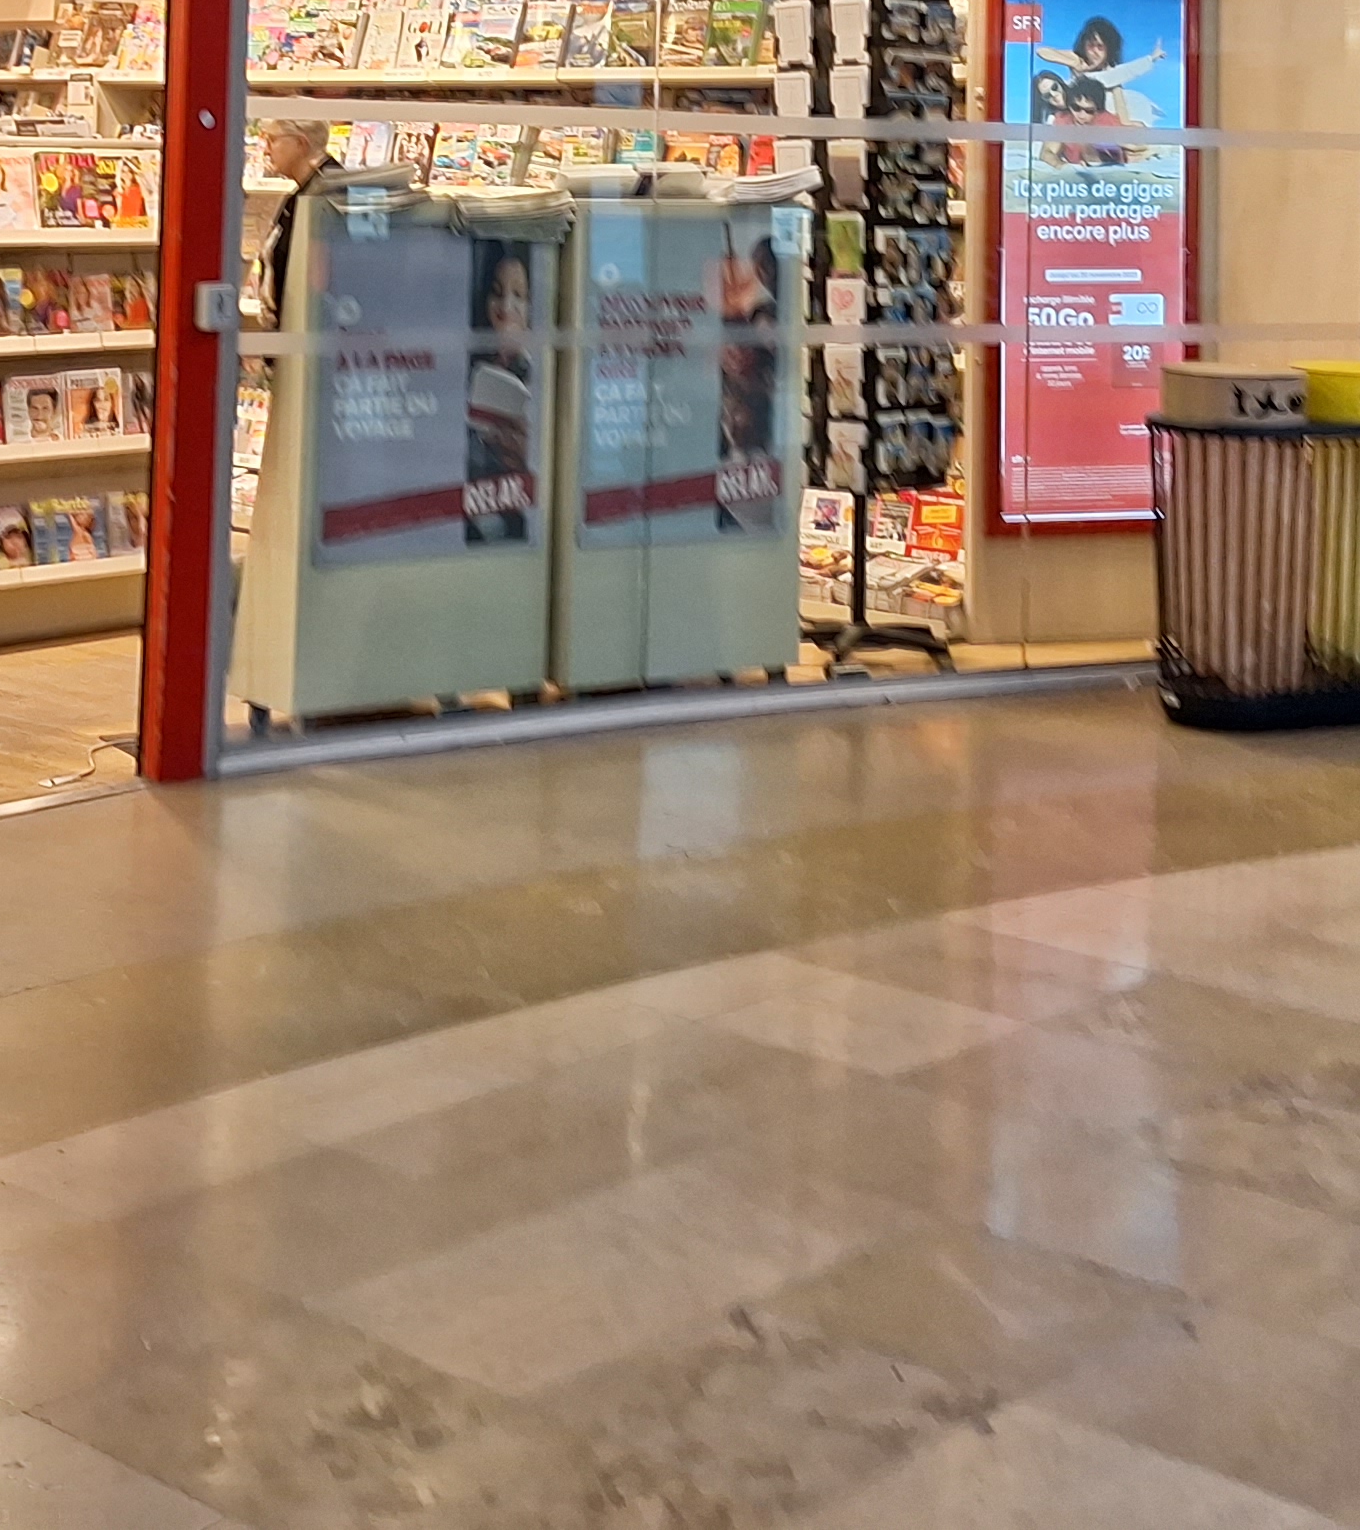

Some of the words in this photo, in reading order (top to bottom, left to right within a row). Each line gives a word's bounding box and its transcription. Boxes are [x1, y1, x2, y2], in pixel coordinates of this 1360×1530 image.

[1012, 15, 1041, 31] SFR
[1046, 179, 1088, 203] plus
[1091, 179, 1117, 198] de
[1120, 179, 1174, 204] gigas
[1076, 201, 1162, 224] partager
[1036, 224, 1107, 241] encore
[1108, 222, 1152, 247] plus
